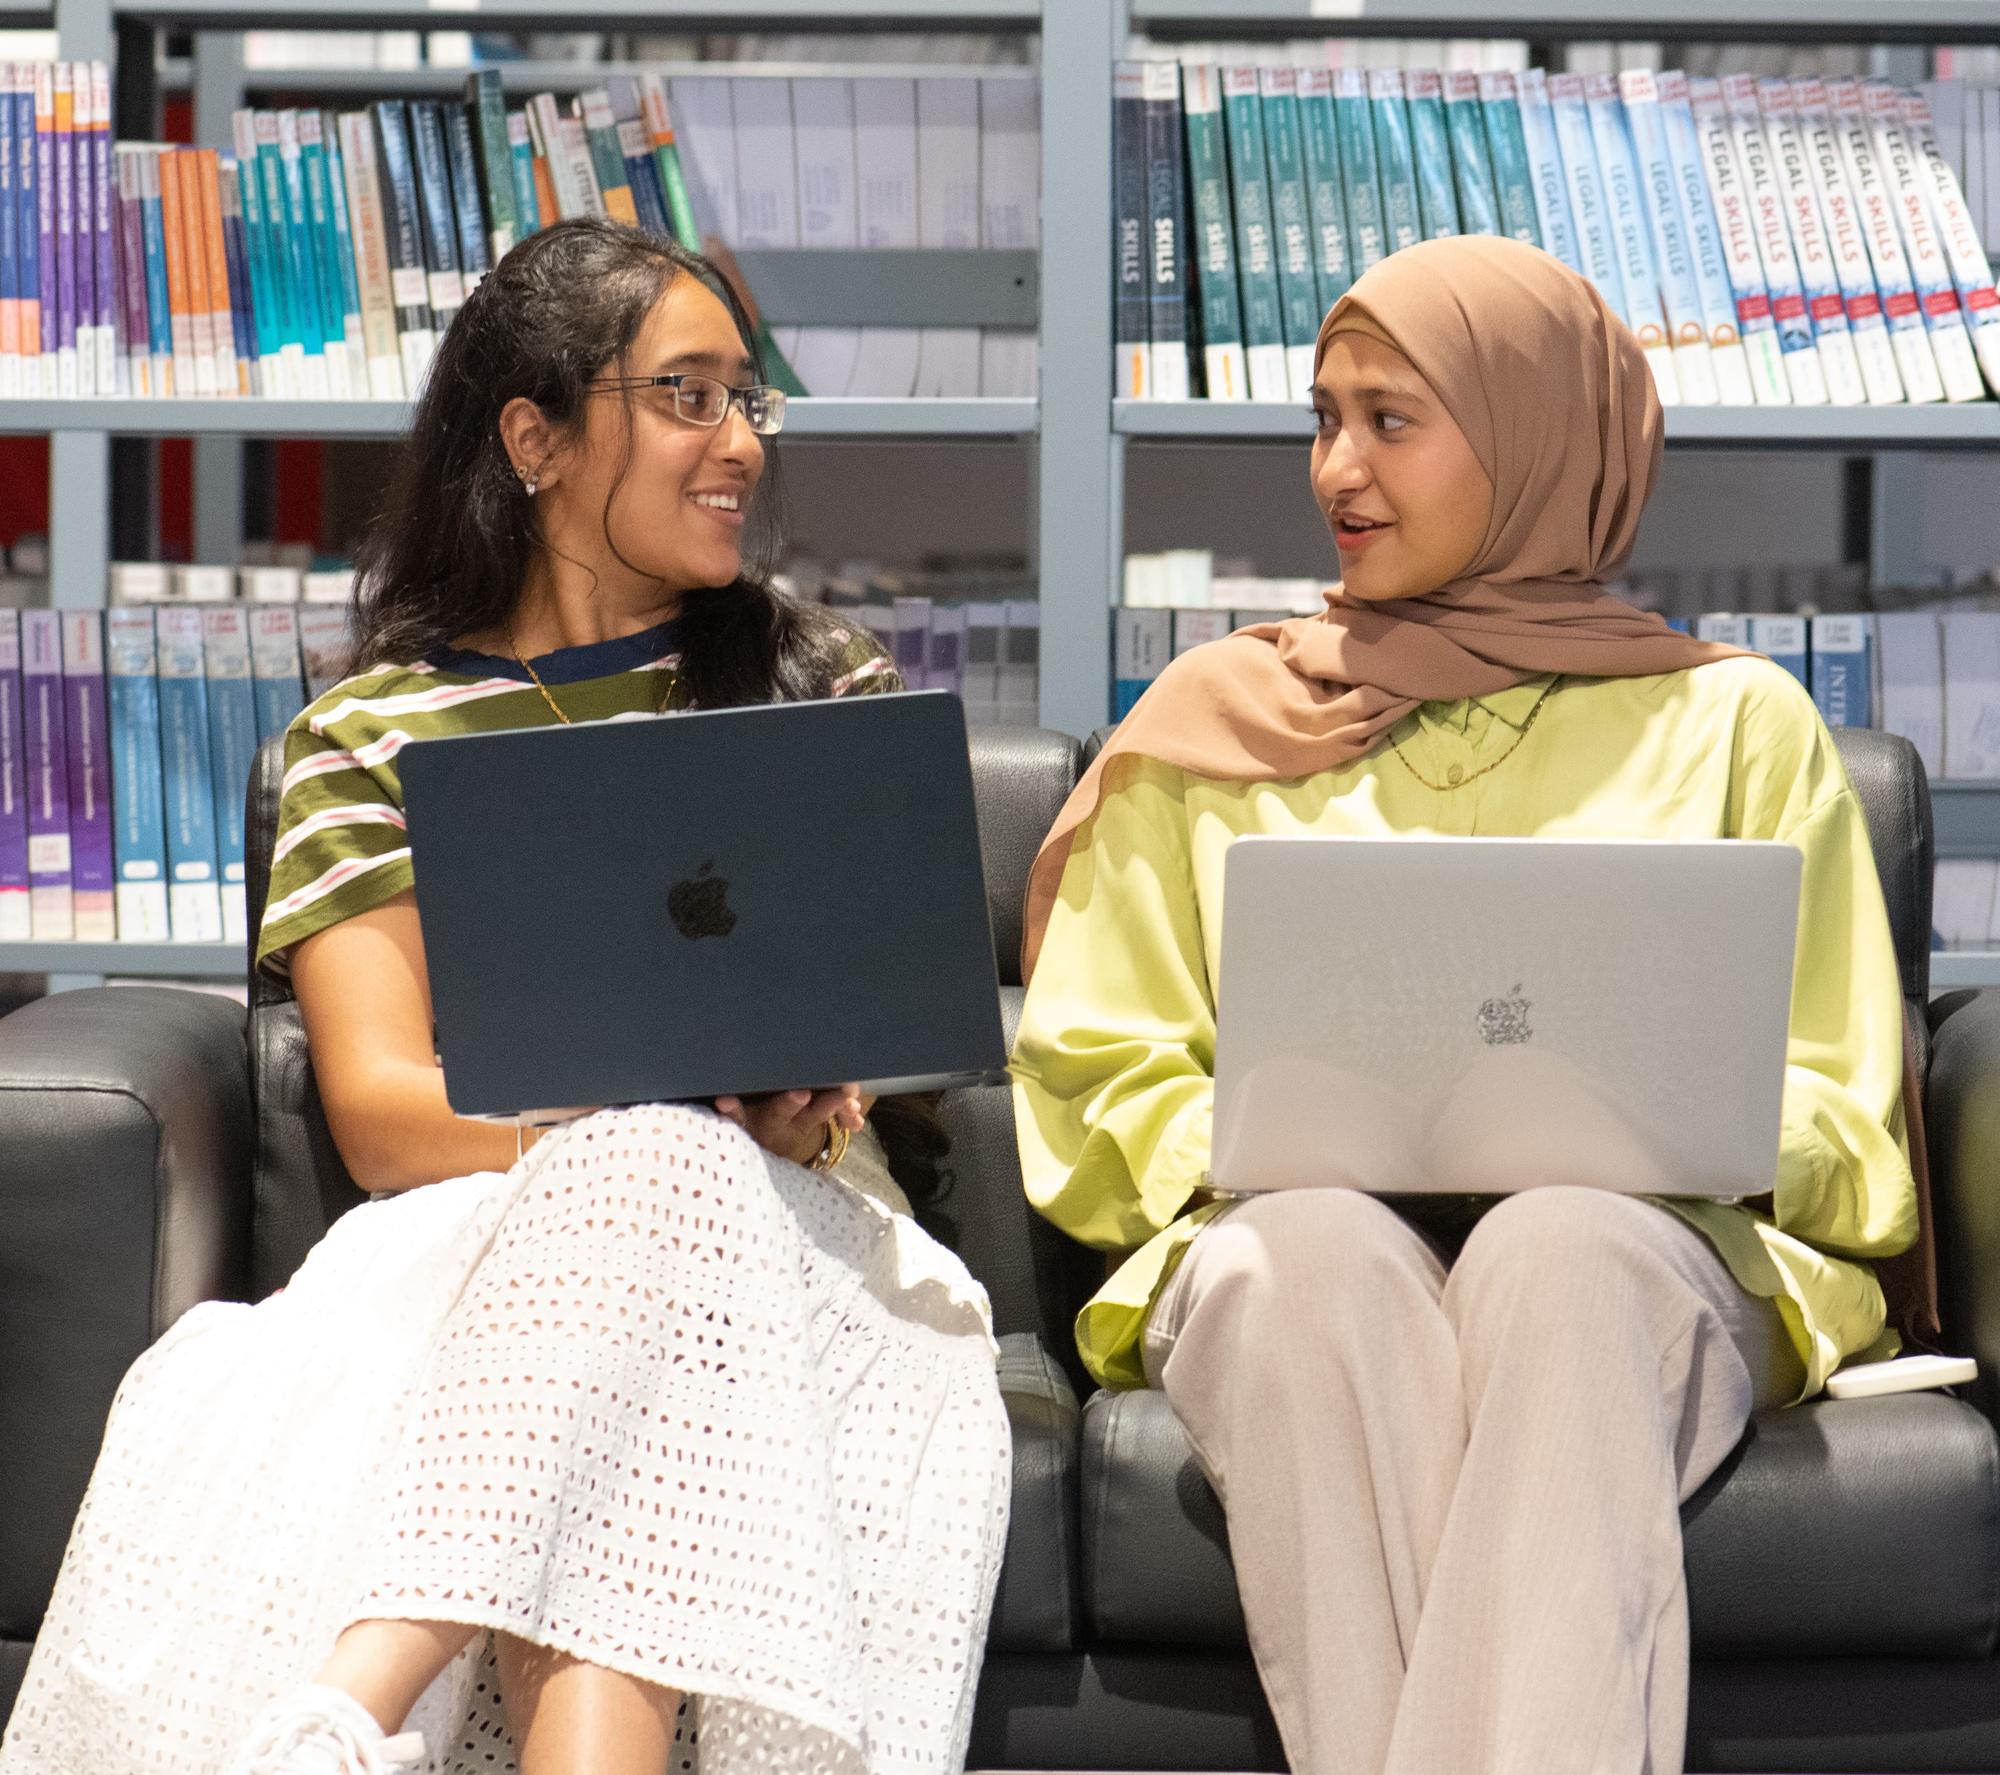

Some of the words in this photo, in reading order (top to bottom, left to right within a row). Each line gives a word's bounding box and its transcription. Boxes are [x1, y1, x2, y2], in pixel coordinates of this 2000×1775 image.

[1206, 222, 1227, 272] skills
[1540, 162, 1562, 218] LEGAL
[1576, 164, 1597, 220] LEGAL
[1611, 164, 1633, 218] LEGAL
[1622, 224, 1645, 278] SKILLS
[1650, 161, 1672, 216] LEGAL
[1662, 222, 1686, 276] SKILLS
[1682, 164, 1704, 218] LEGAL
[1695, 224, 1718, 278] SKILLS
[1708, 130, 1733, 190] LEGAL
[1722, 196, 1750, 263] SKILLS
[1744, 130, 1768, 190] LEGAL
[1758, 196, 1786, 263] SKILLS
[1779, 130, 1804, 190] LEGAL
[1794, 196, 1823, 262] SKILLS
[1814, 130, 1840, 190] LEGAL
[1830, 196, 1858, 262] SKILLS
[1849, 130, 1874, 190] LEGAL
[1866, 196, 1896, 261] SKILLS
[1887, 130, 1912, 190] LEGAL
[1904, 195, 1934, 260] SKILLS
[1922, 140, 1950, 192] LEGAL
[1944, 200, 1974, 258] SKILLS
[1121, 217, 1140, 283] SKILLS
[1155, 217, 1176, 284] SKILLS
[1248, 224, 1269, 274] skills
[1285, 224, 1306, 274] skills
[1322, 224, 1344, 274] skills
[1586, 225, 1610, 279] SKILLS
